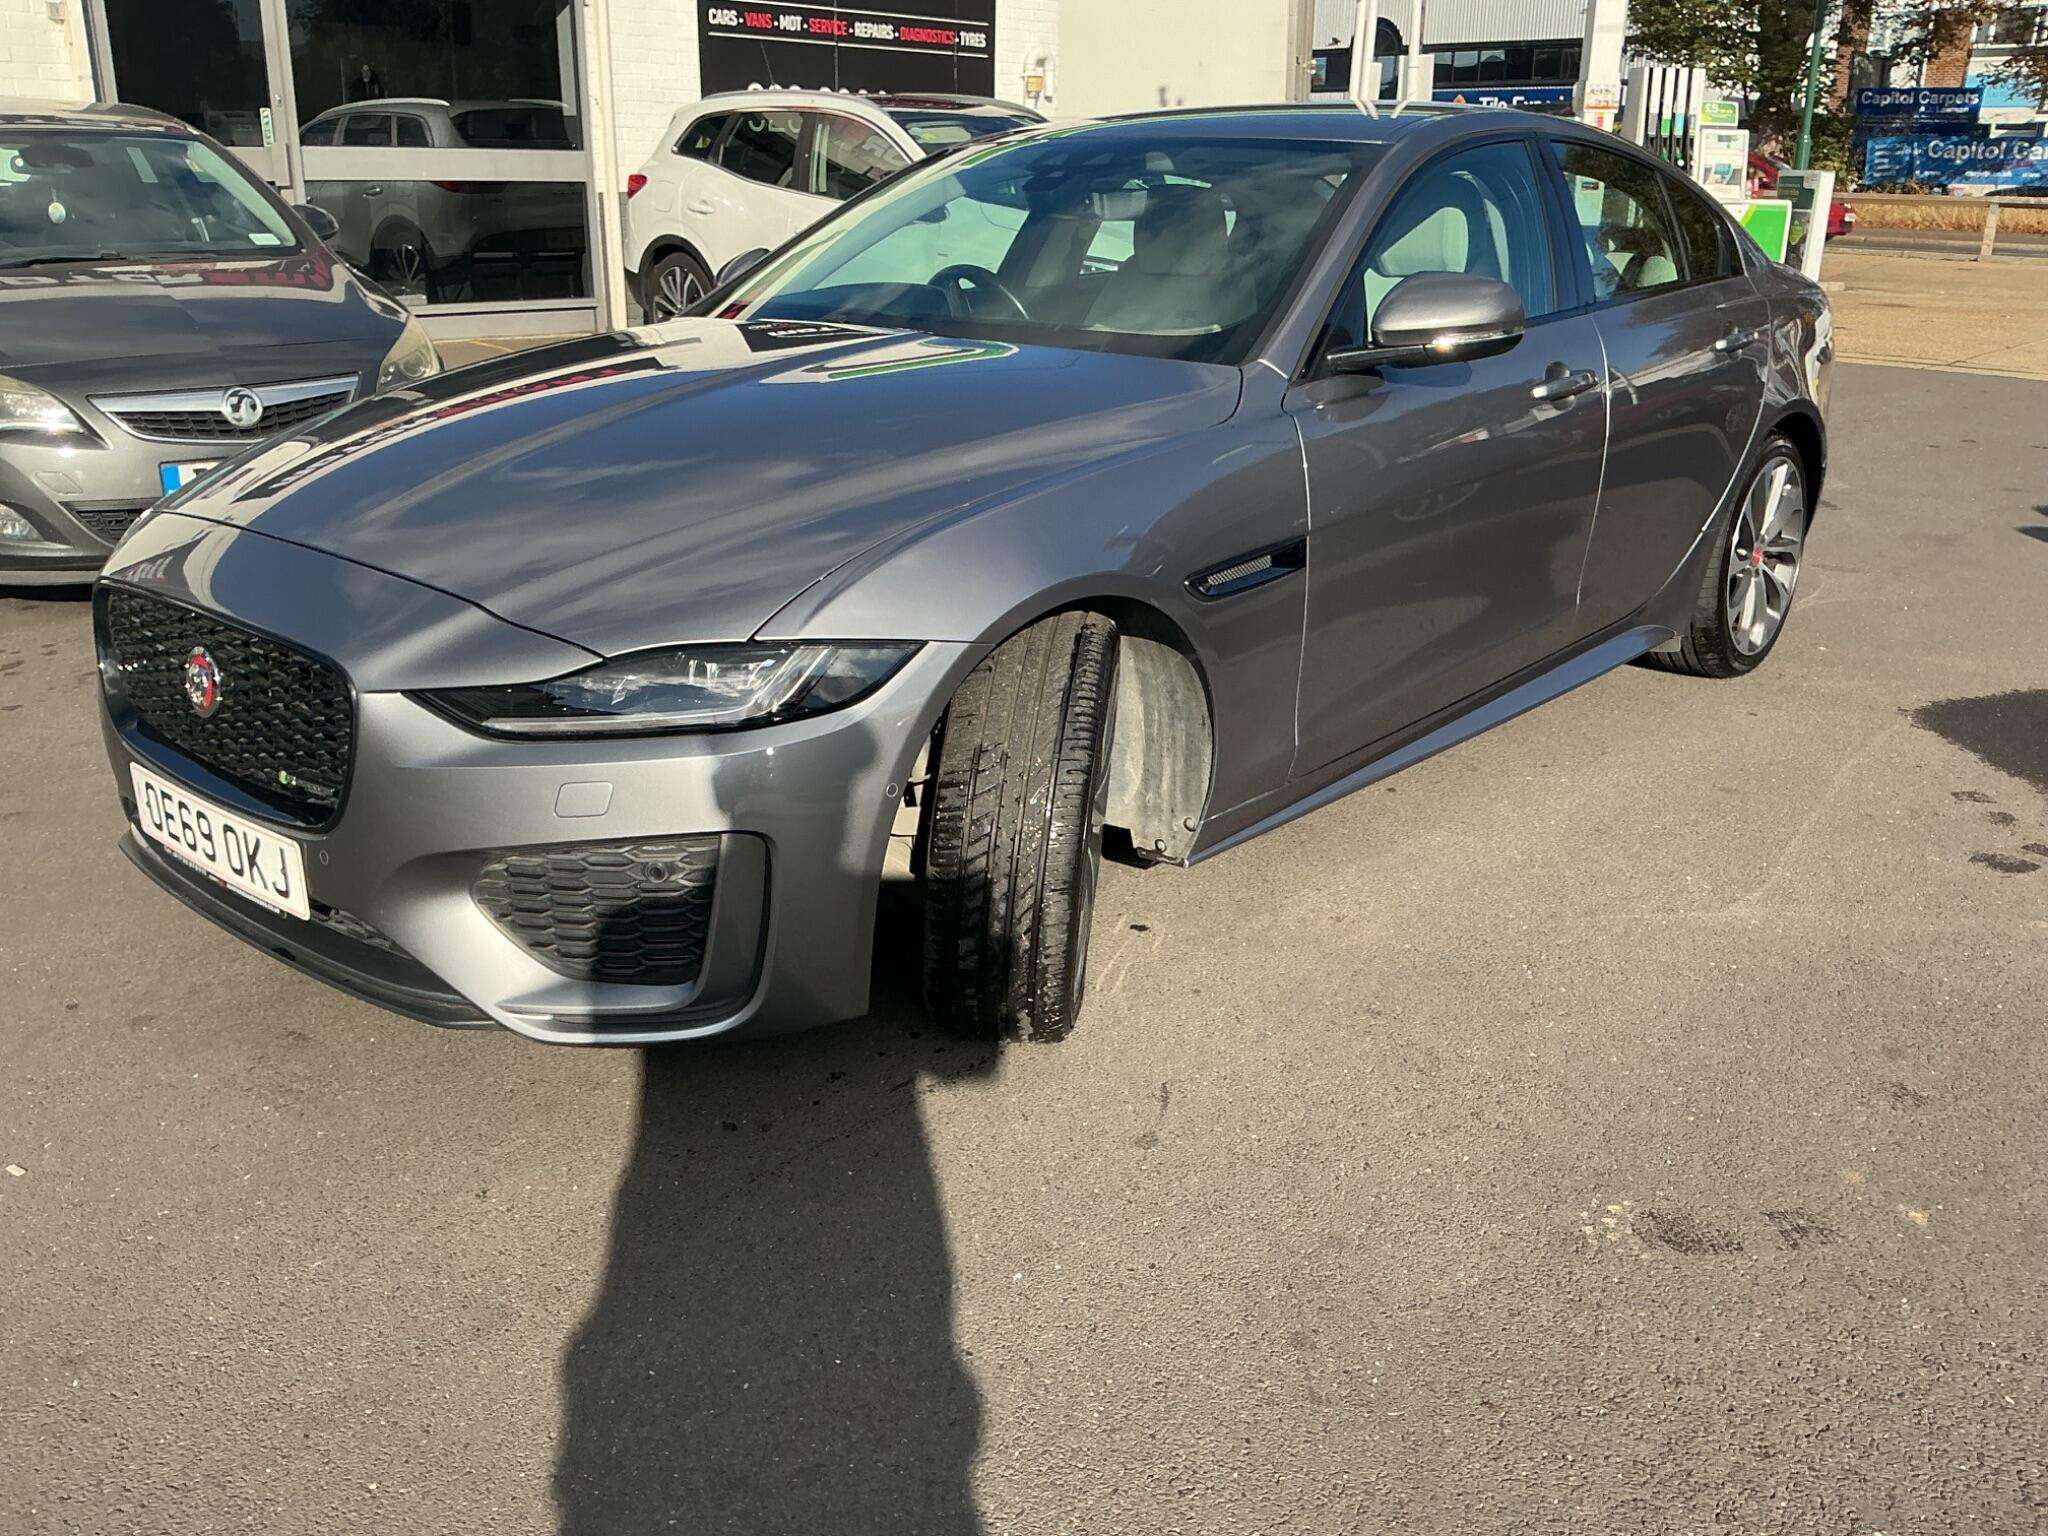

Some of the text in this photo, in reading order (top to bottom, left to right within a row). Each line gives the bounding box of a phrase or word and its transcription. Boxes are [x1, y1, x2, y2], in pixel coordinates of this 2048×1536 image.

[708, 8, 987, 48] CARS VANS MOT SERVICE REPAIRS DIAGNOSTICS TYRES
[1861, 91, 1979, 107] Capitol Carpets
[1928, 140, 2006, 164] Capitol
